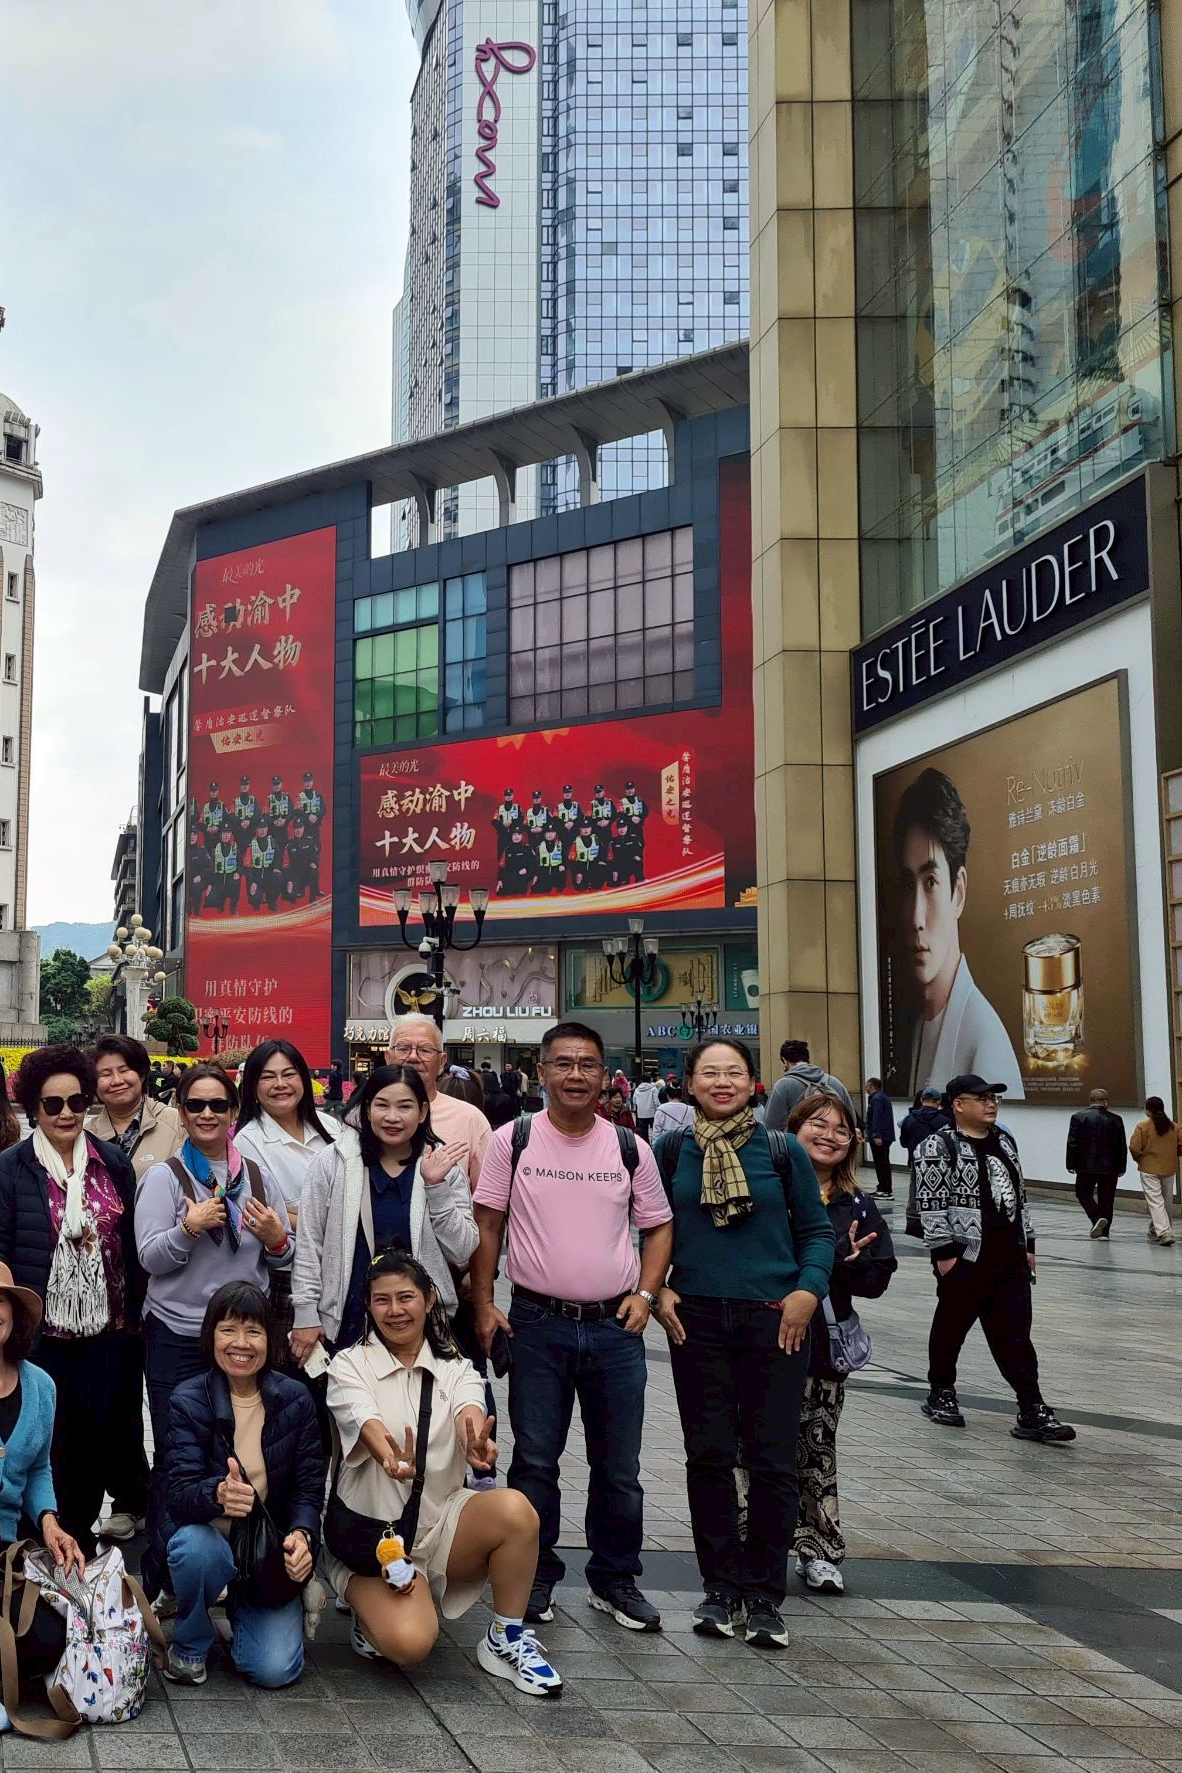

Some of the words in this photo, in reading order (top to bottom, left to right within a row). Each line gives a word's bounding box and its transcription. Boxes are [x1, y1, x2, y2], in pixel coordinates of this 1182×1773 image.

[862, 616, 945, 712] ESTÉE
[958, 519, 1119, 662] LAUDER
[193, 634, 303, 686] 十大人物
[221, 729, 266, 747] 佑安之光
[378, 758, 420, 779] 最美的光
[1007, 755, 1084, 806] Re-Nutriv
[376, 780, 475, 819] 感动渝中
[665, 774, 676, 820] 佑安之光
[1008, 803, 1043, 830] 雅诗兰黛
[374, 822, 477, 859] 十大人物
[204, 978, 278, 998] 用真情守护
[462, 1006, 504, 1018] ZHOU
[506, 1006, 530, 1018] LIU
[531, 1006, 552, 1017] FU
[344, 1025, 390, 1042] 巧克力馆
[461, 1026, 508, 1043] 周六福
[646, 1025, 677, 1037] ABC
[536, 1168, 584, 1181] MAISON
[588, 1170, 623, 1183] KEEPS
